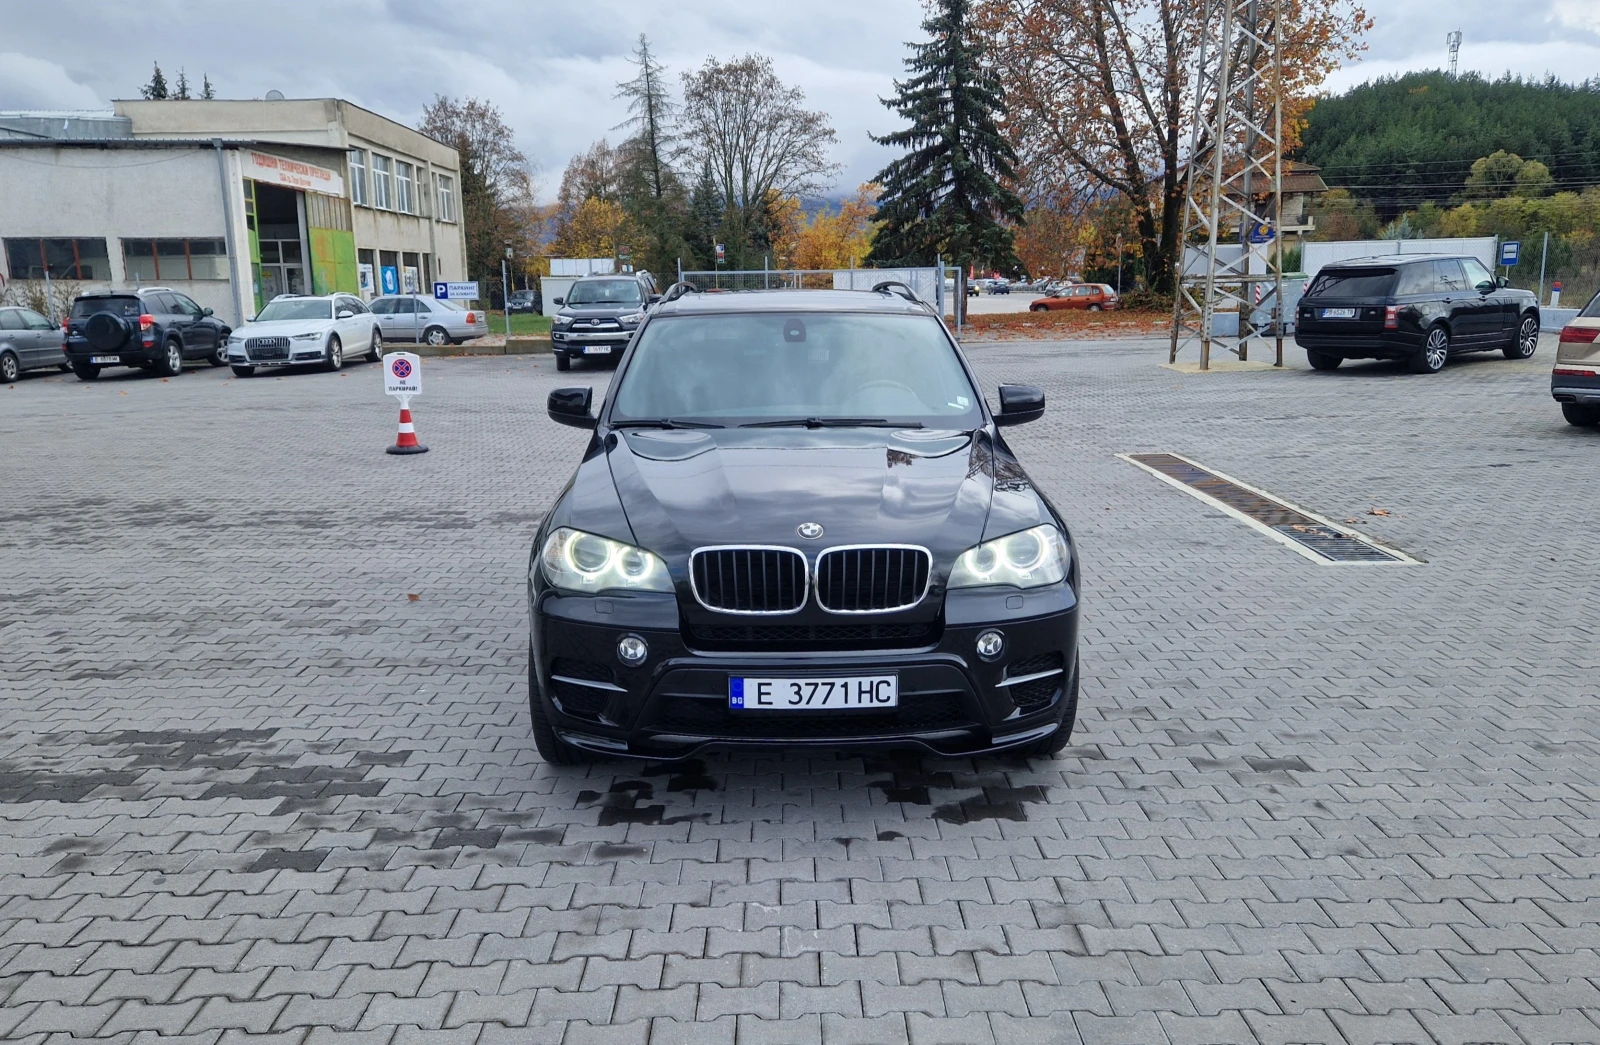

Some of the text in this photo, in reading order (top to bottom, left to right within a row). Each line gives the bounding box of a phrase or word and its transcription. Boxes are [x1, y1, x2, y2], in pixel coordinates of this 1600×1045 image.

[437, 285, 446, 297] P
[757, 682, 773, 705] E
[731, 697, 743, 705] BG
